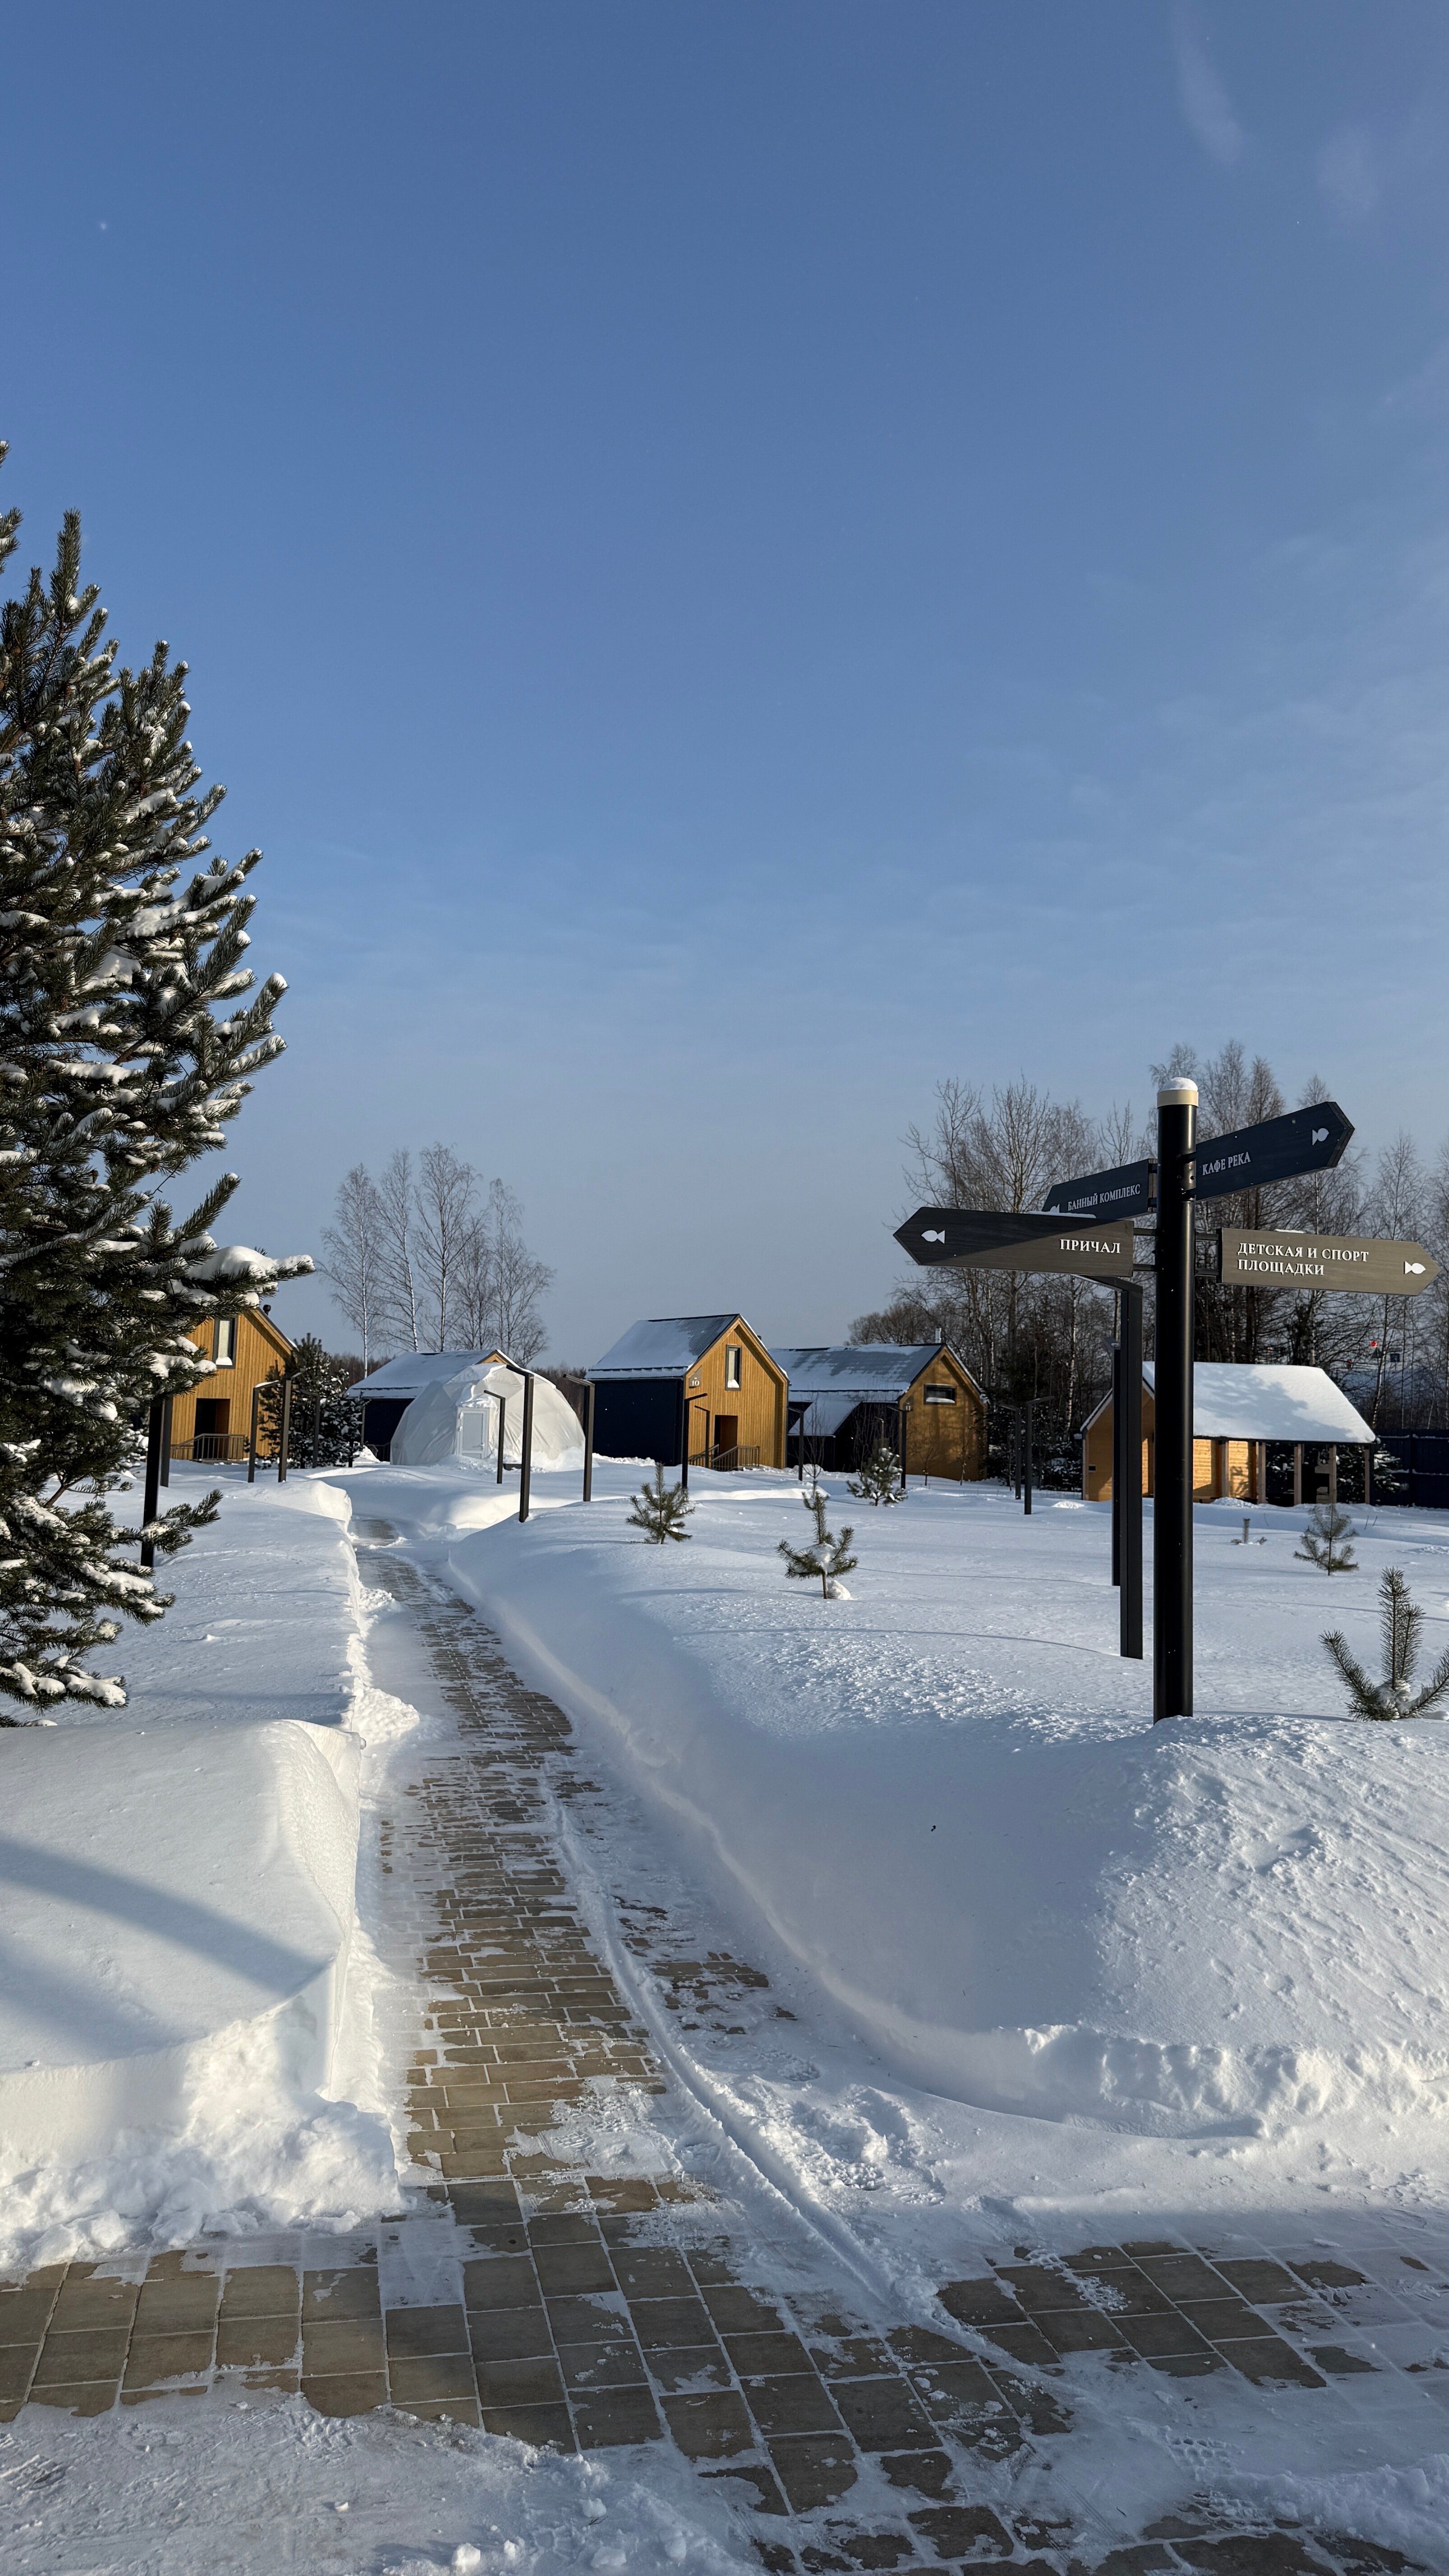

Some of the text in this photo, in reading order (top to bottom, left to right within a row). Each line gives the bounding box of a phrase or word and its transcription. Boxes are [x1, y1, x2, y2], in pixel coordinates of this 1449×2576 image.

[1202, 1151, 1251, 1176] КАФЕ РЕКА
[1068, 1184, 1141, 1211] БАННЫЙ КОМПЛЕКС
[1060, 1239, 1121, 1254] ПРИЧАЛ
[1237, 1242, 1369, 1262] ДЕТСКАЯ И СПОРТ
[1237, 1259, 1325, 1276] ПЛОЩАДКИ
